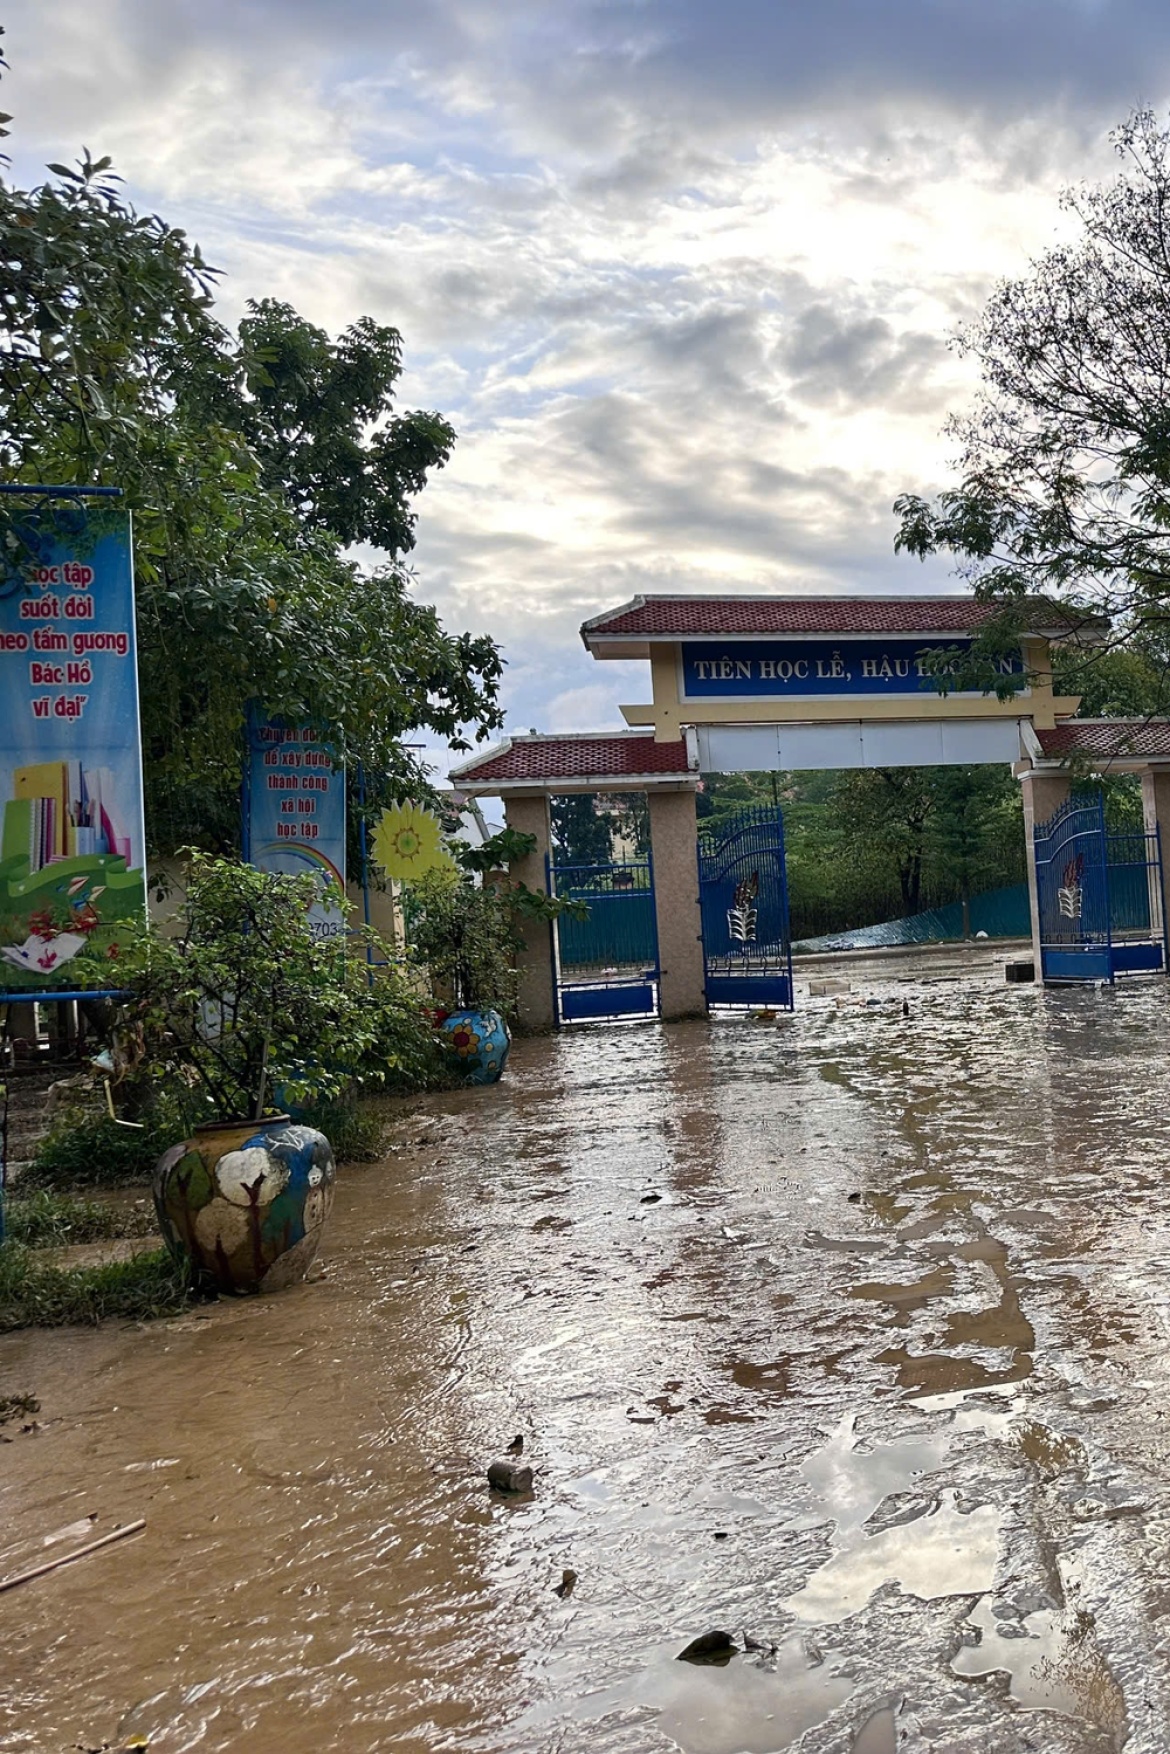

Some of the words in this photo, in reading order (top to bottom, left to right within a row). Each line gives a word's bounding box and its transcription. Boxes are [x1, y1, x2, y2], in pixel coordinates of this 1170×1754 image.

[26, 564, 59, 589] ọc
[62, 562, 93, 589] tập
[20, 593, 60, 619] suốt
[64, 595, 93, 619] đời
[32, 625, 68, 651] tấm
[72, 632, 129, 656] gương
[31, 662, 62, 684] Bác
[759, 659, 810, 683] HỌC
[815, 650, 852, 682] LỄ,
[861, 656, 910, 682] HẬU
[33, 697, 50, 718] vĩ
[281, 750, 301, 768] xây
[267, 774, 299, 790] thành
[302, 774, 328, 792] công
[297, 797, 316, 816] hội
[276, 821, 298, 839] học
[301, 821, 319, 840] tập
